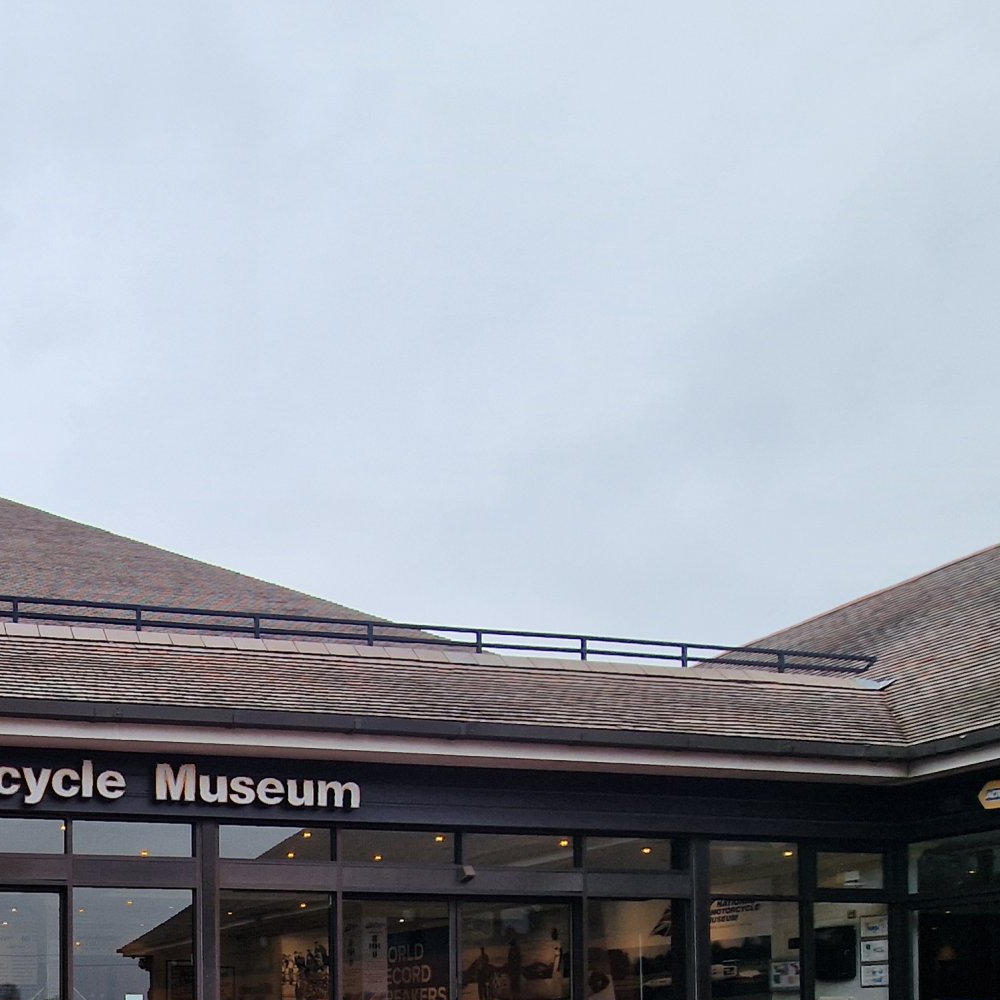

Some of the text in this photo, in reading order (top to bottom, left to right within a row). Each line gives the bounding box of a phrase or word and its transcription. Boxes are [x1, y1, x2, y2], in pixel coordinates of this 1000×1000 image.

[154, 763, 360, 808] Museum
[388, 943, 424, 963] ORLD
[387, 965, 431, 985] ECORD
